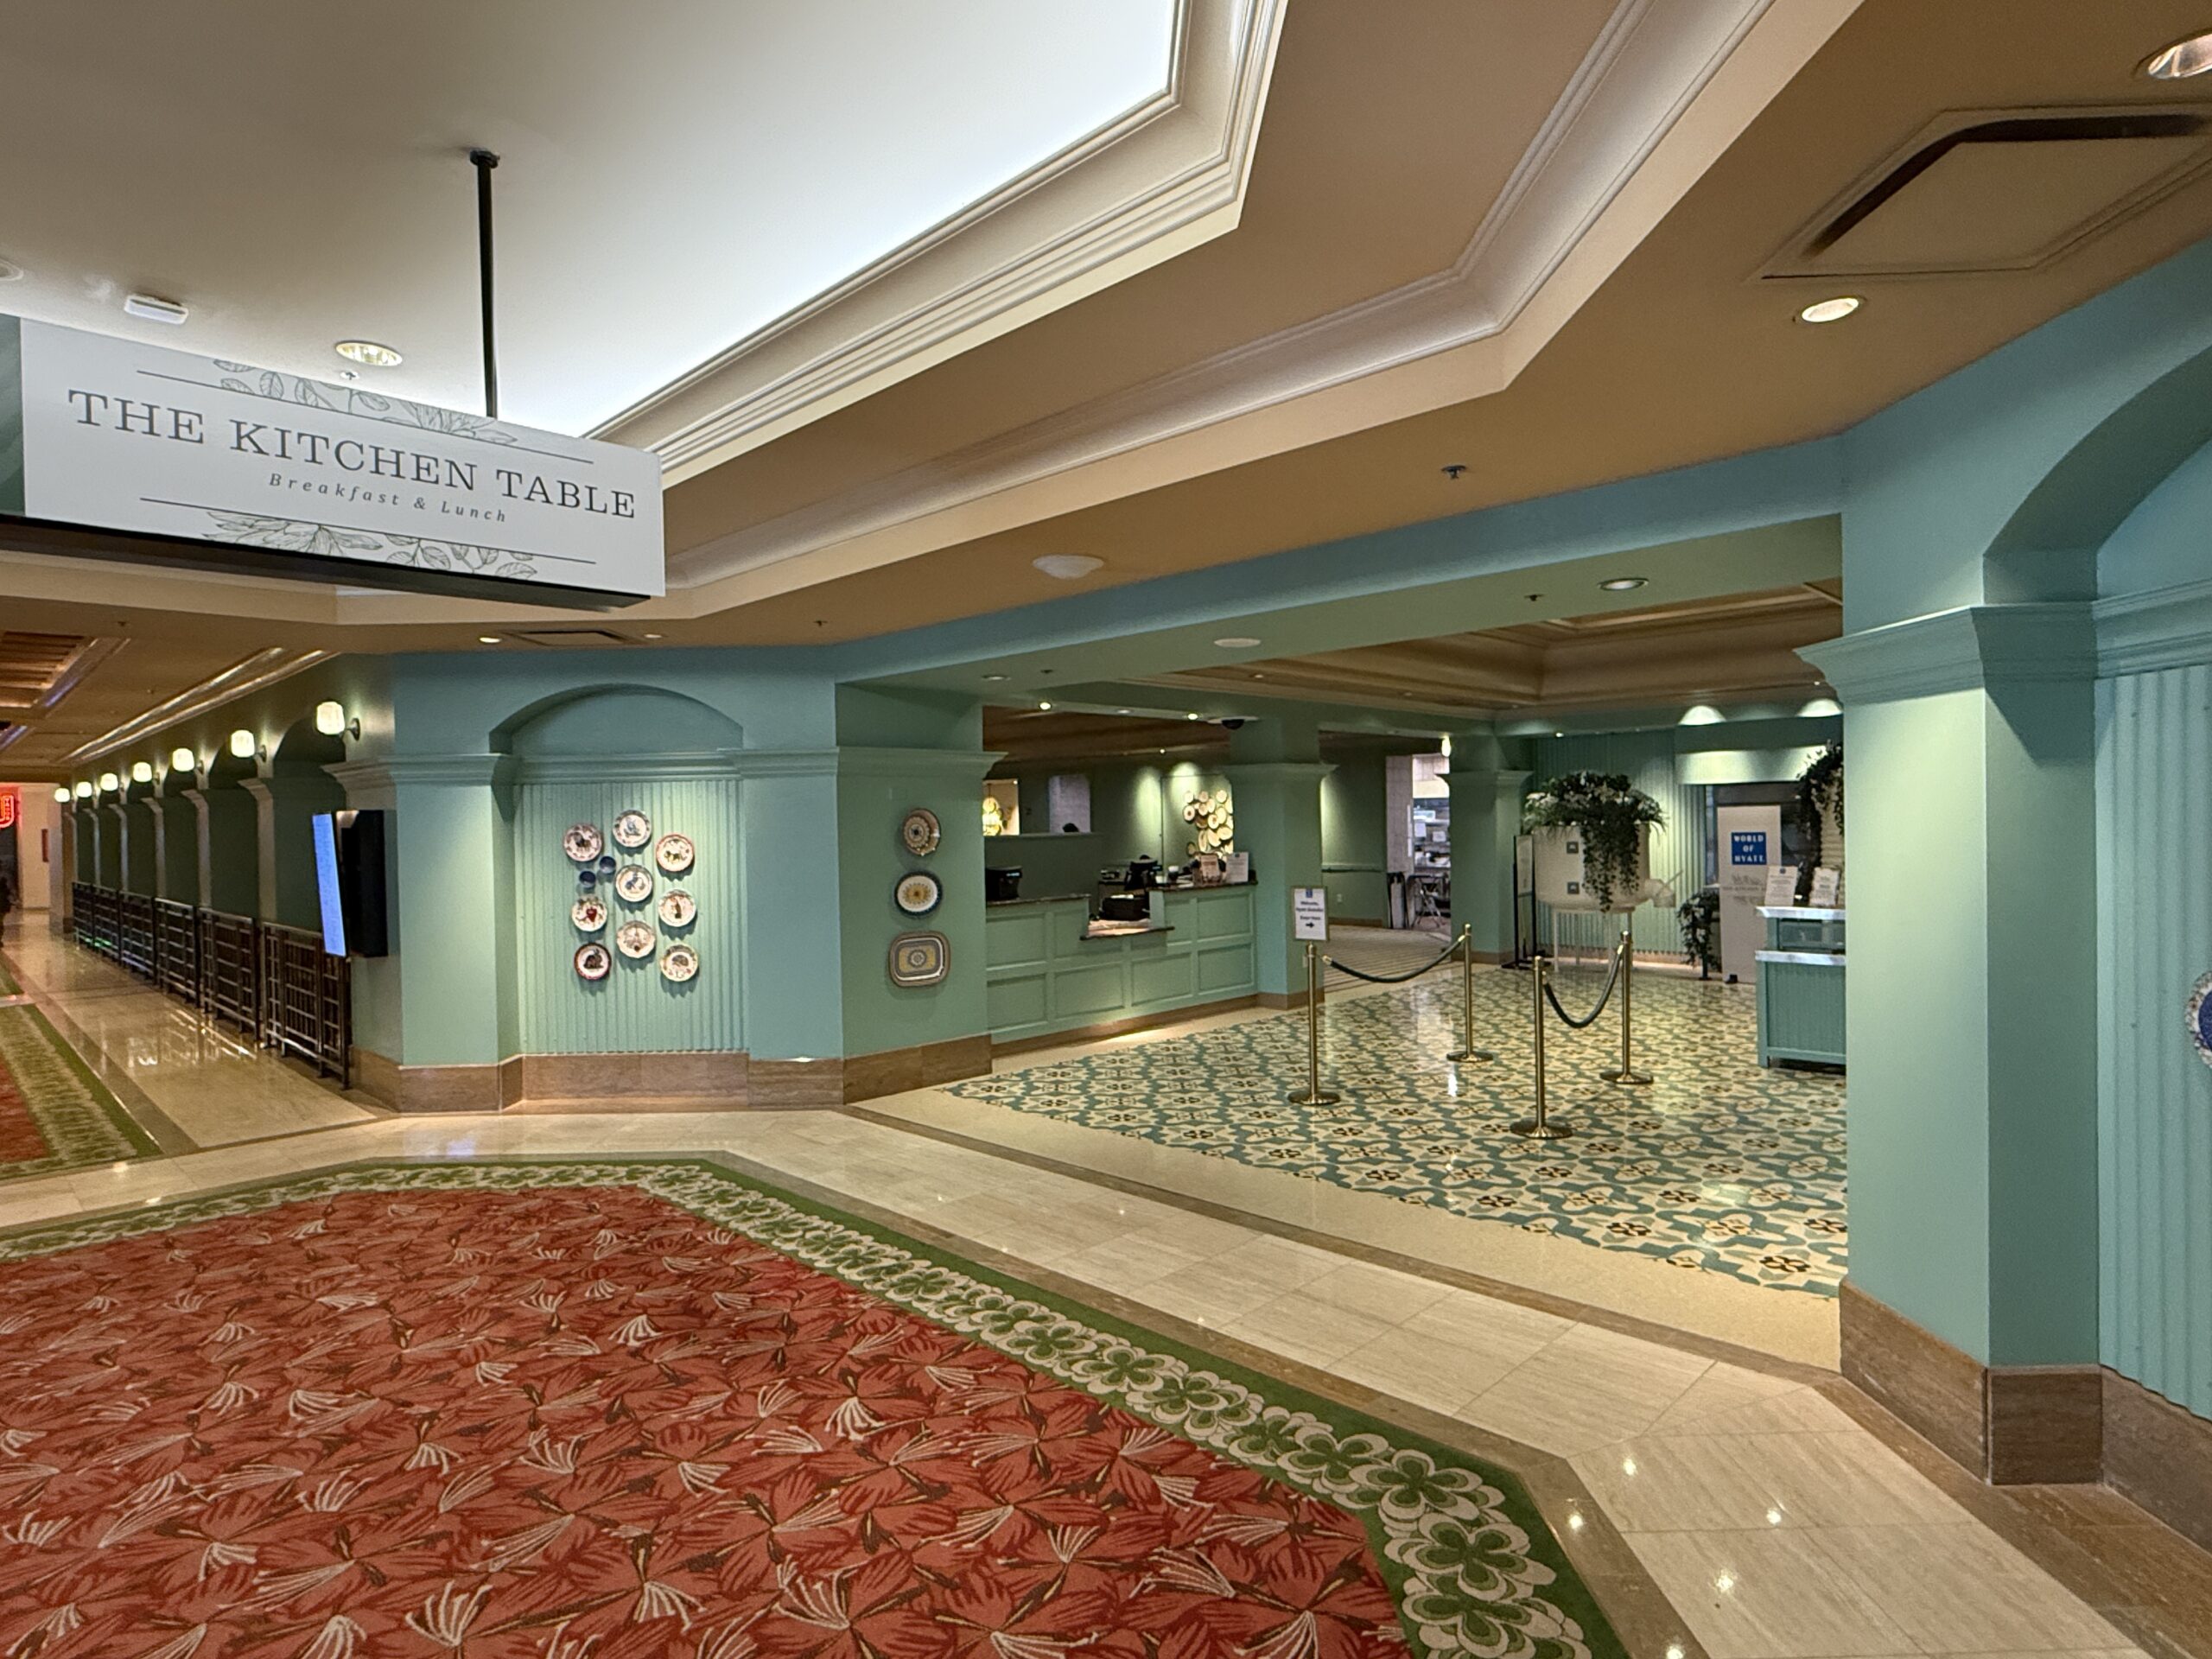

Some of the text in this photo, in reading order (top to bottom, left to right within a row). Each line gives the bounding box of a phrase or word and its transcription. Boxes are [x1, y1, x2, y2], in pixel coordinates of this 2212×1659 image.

[68, 388, 636, 519] THE KITCHEN TABLE
[269, 472, 506, 523] Breakfast & Lunch
[1743, 844, 1754, 853] OF
